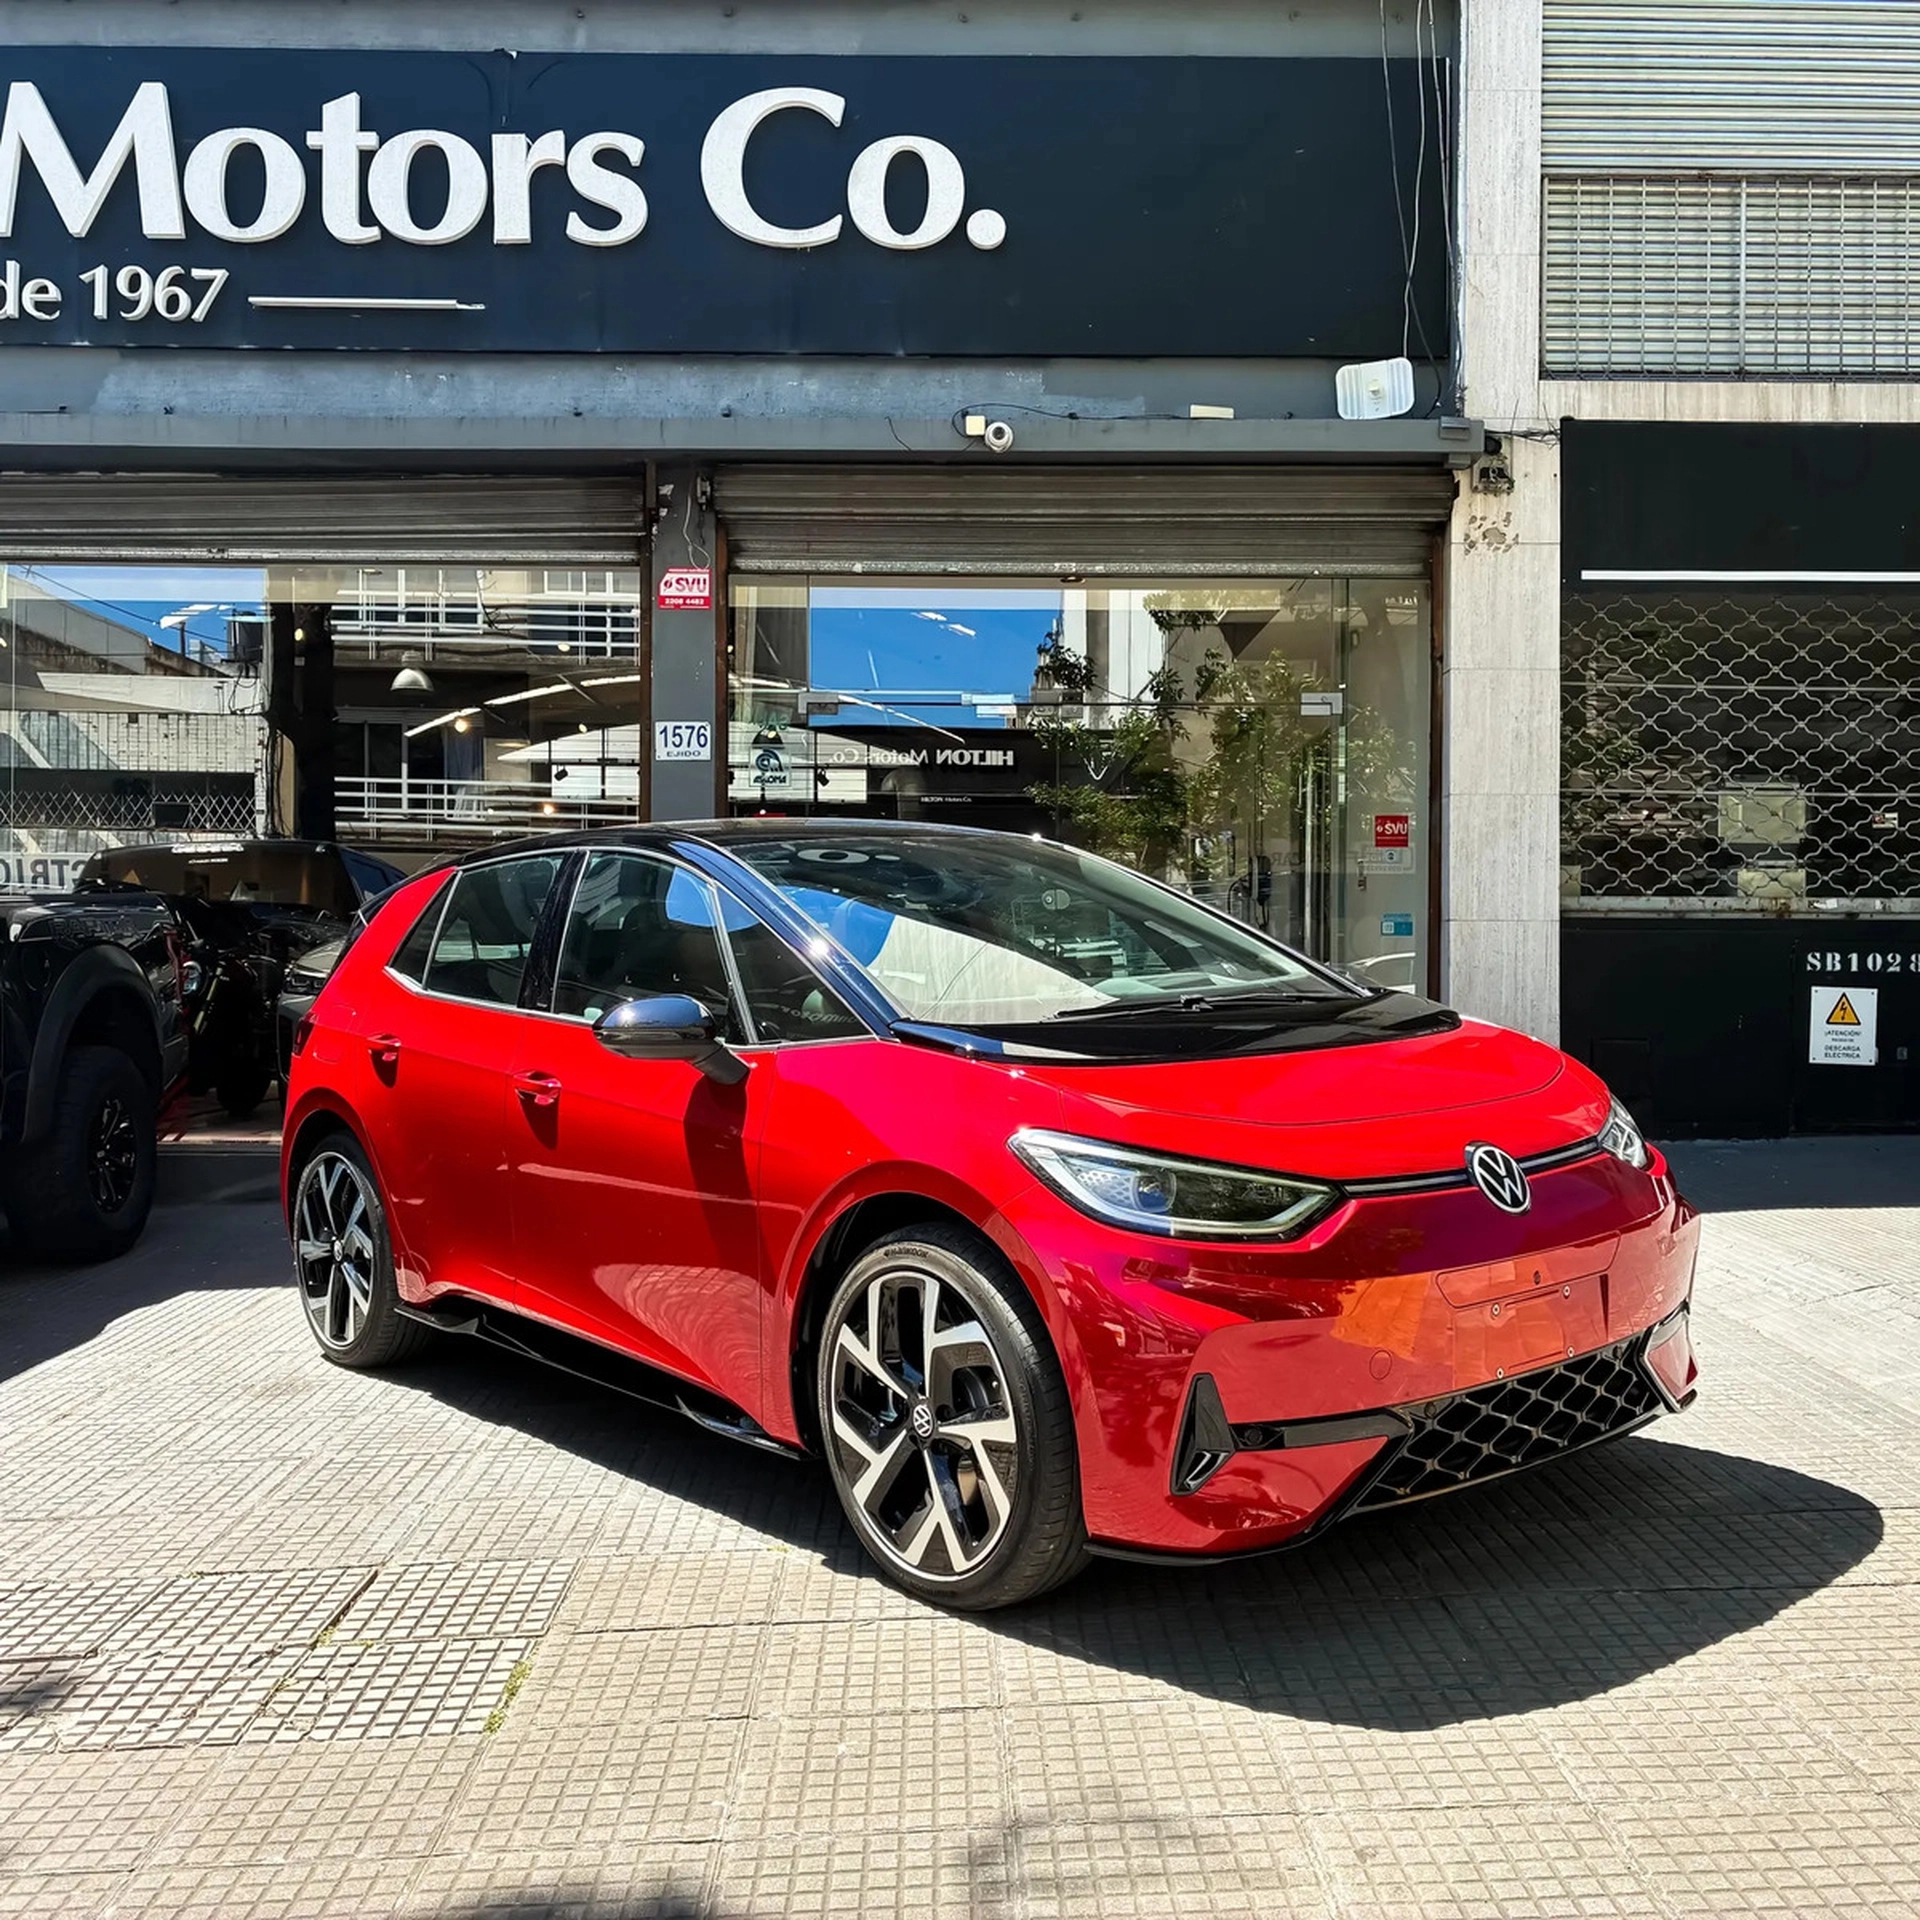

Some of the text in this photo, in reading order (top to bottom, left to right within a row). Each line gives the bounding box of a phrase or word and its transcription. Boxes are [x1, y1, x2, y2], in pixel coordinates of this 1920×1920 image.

[0, 82, 1007, 250] Motors Co.
[79, 264, 230, 322] 1967
[675, 577, 706, 593] SVU
[659, 725, 708, 748] 1576
[1384, 823, 1408, 835] SVU
